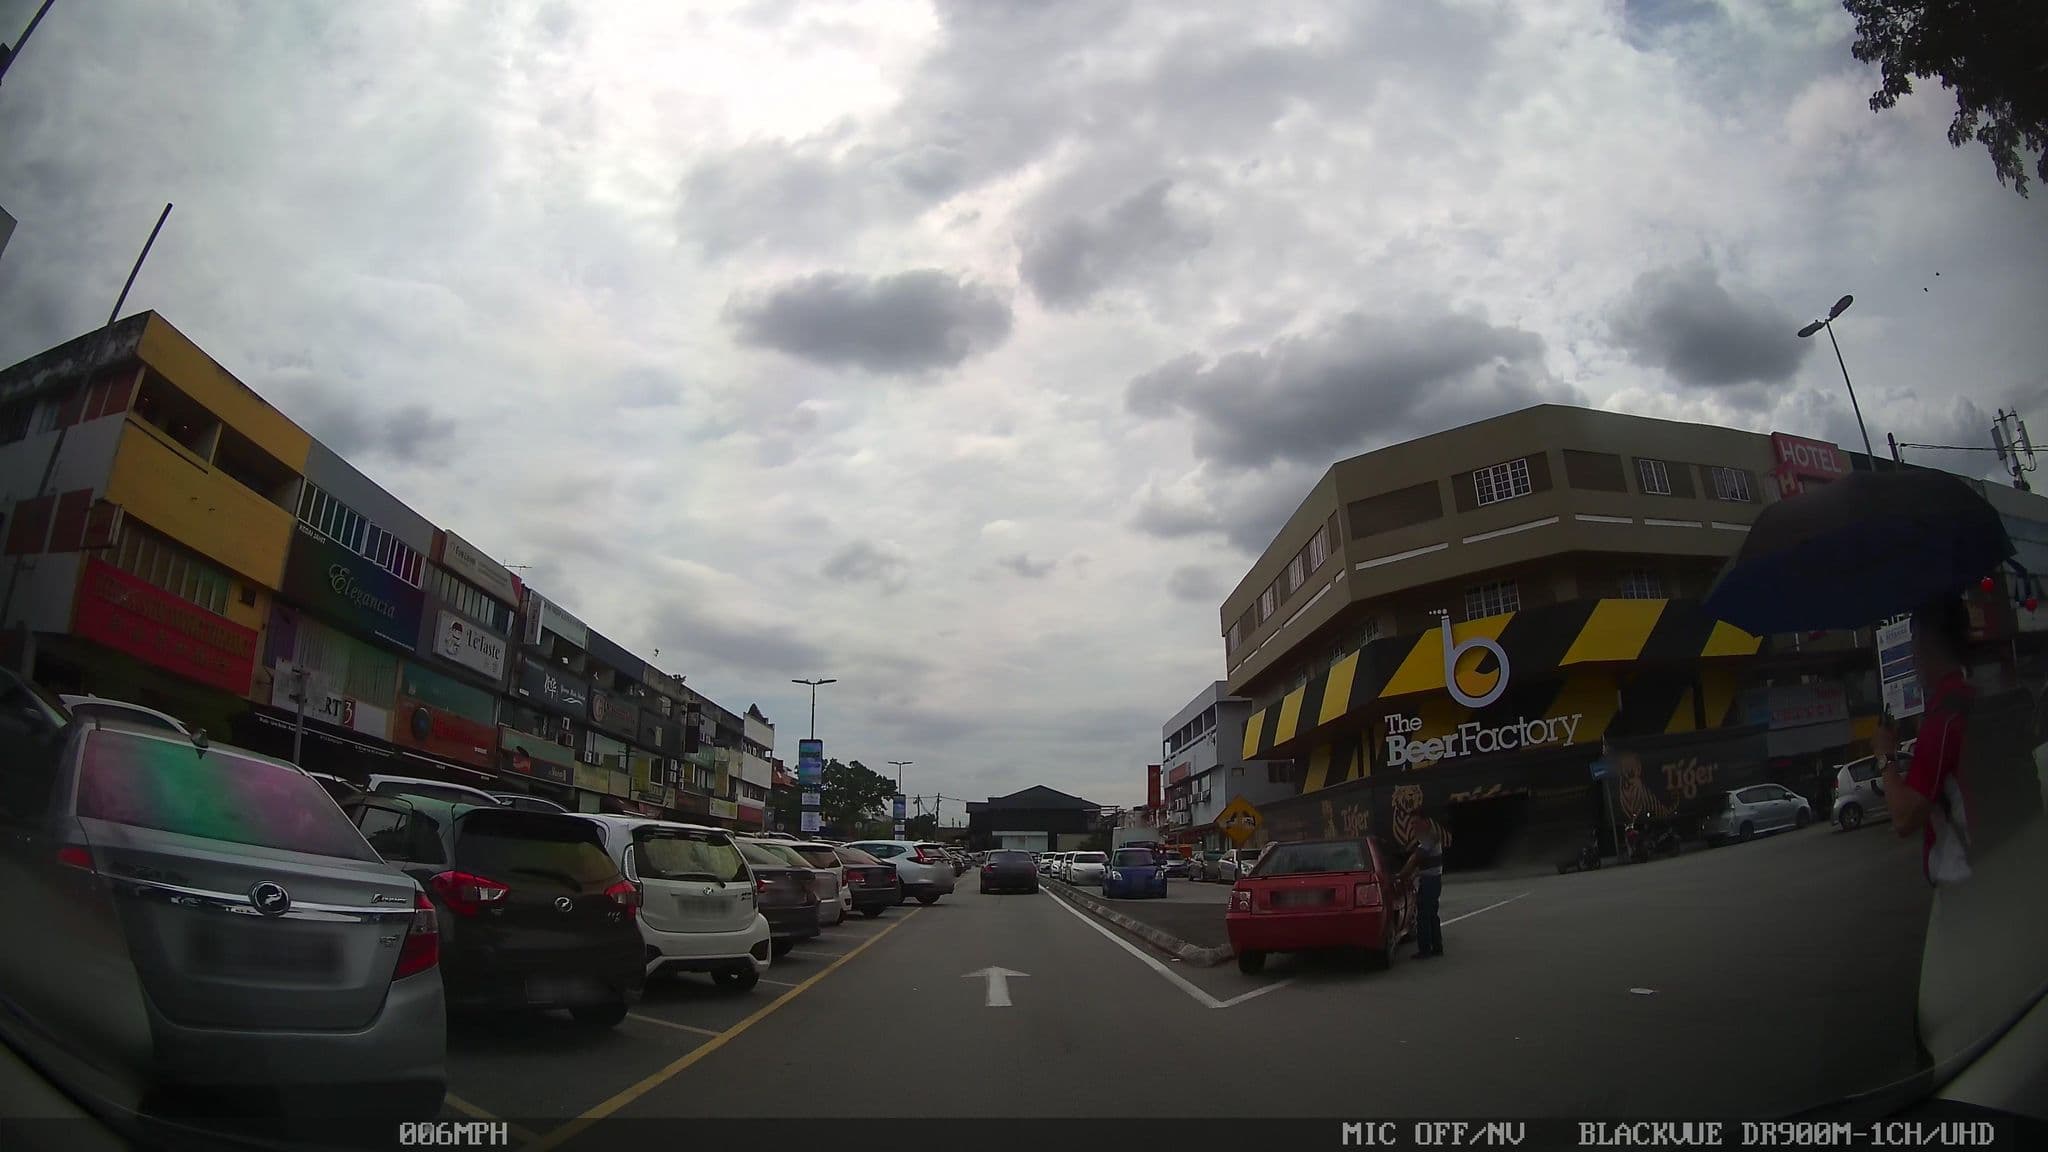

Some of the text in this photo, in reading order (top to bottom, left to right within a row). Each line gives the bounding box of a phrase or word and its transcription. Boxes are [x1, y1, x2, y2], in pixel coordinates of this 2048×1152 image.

[1779, 440, 1841, 472] HOTEL
[329, 563, 395, 618] Elegancia
[1384, 713, 1422, 735] The
[1662, 758, 1716, 799] Tiger
